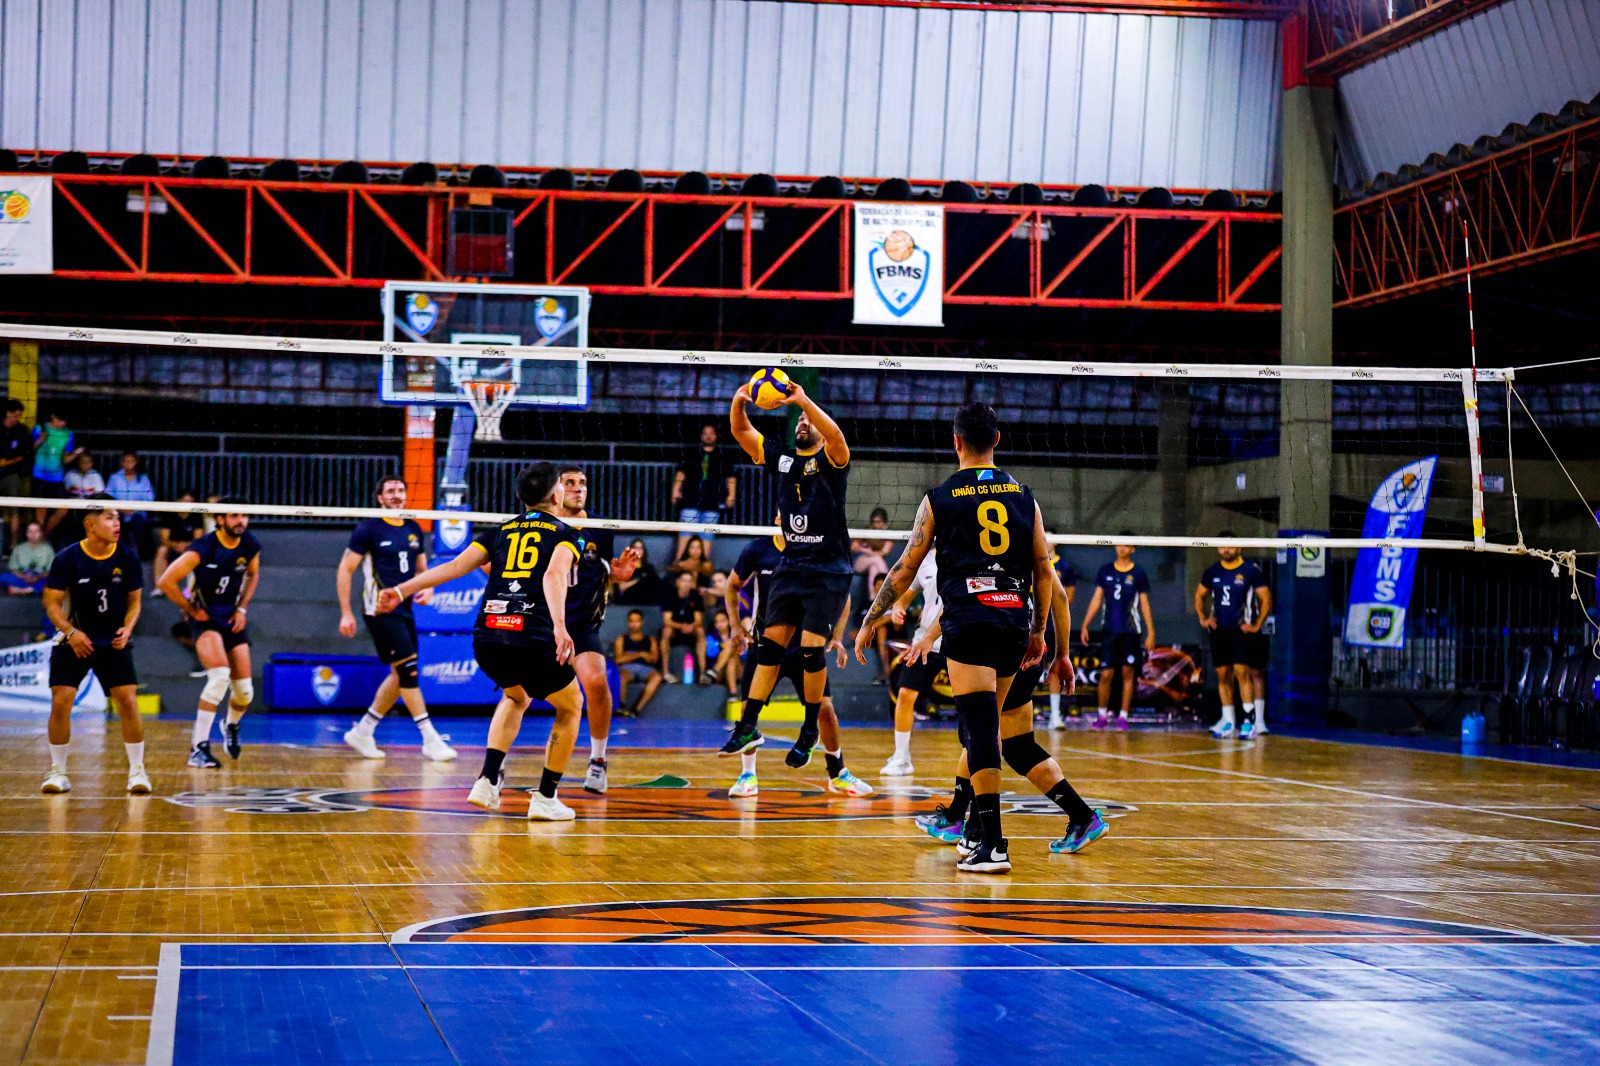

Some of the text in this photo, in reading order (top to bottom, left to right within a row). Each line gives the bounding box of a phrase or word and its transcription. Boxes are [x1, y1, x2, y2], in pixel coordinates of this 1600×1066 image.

[876, 265, 922, 280] FBMS
[952, 483, 1022, 498] UNIÃO CG VOLEIBOL
[977, 500, 1010, 556] 8
[505, 531, 542, 570] 16
[398, 551, 409, 574] 8
[215, 576, 230, 595] 9
[97, 588, 109, 613] 3
